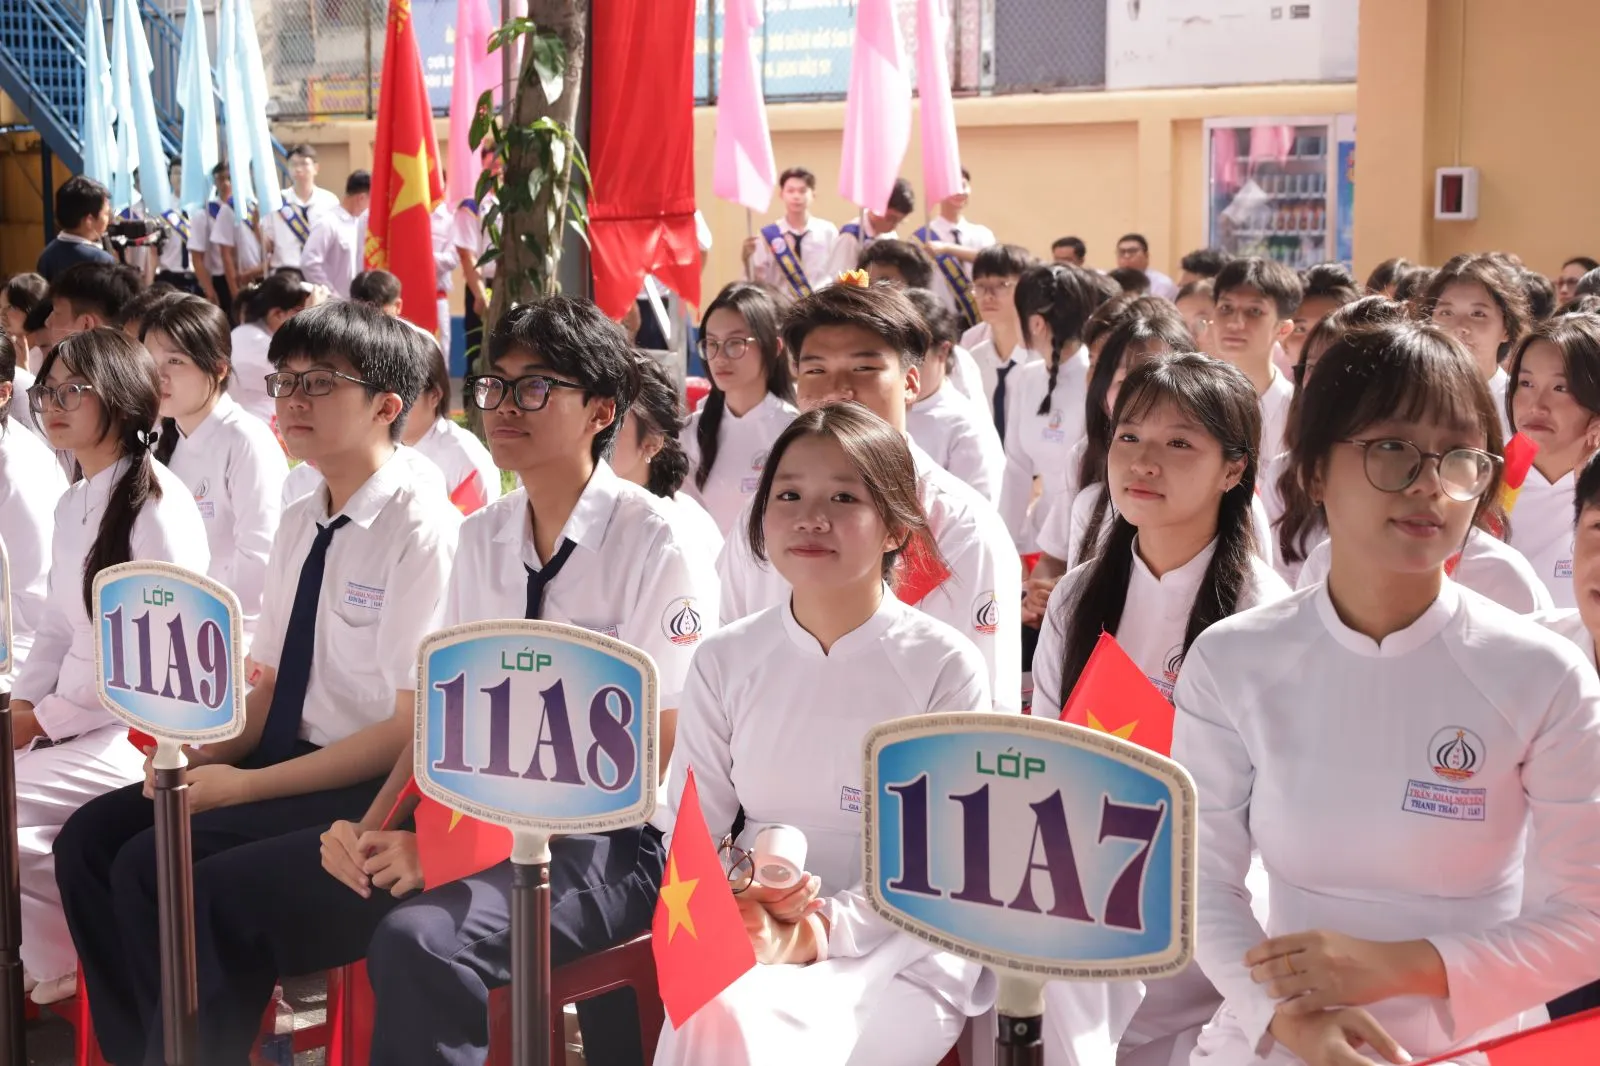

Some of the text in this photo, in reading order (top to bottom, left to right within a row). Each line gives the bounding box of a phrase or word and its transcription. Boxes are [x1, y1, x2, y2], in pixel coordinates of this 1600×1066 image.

[143, 585, 174, 607] LỚP
[105, 605, 228, 709] 11A9
[501, 646, 552, 672] LỚP
[434, 672, 636, 791] 11A8
[976, 747, 1046, 779] LỚP
[1411, 800, 1436, 811] THANH
[887, 774, 1165, 931] 11A7
